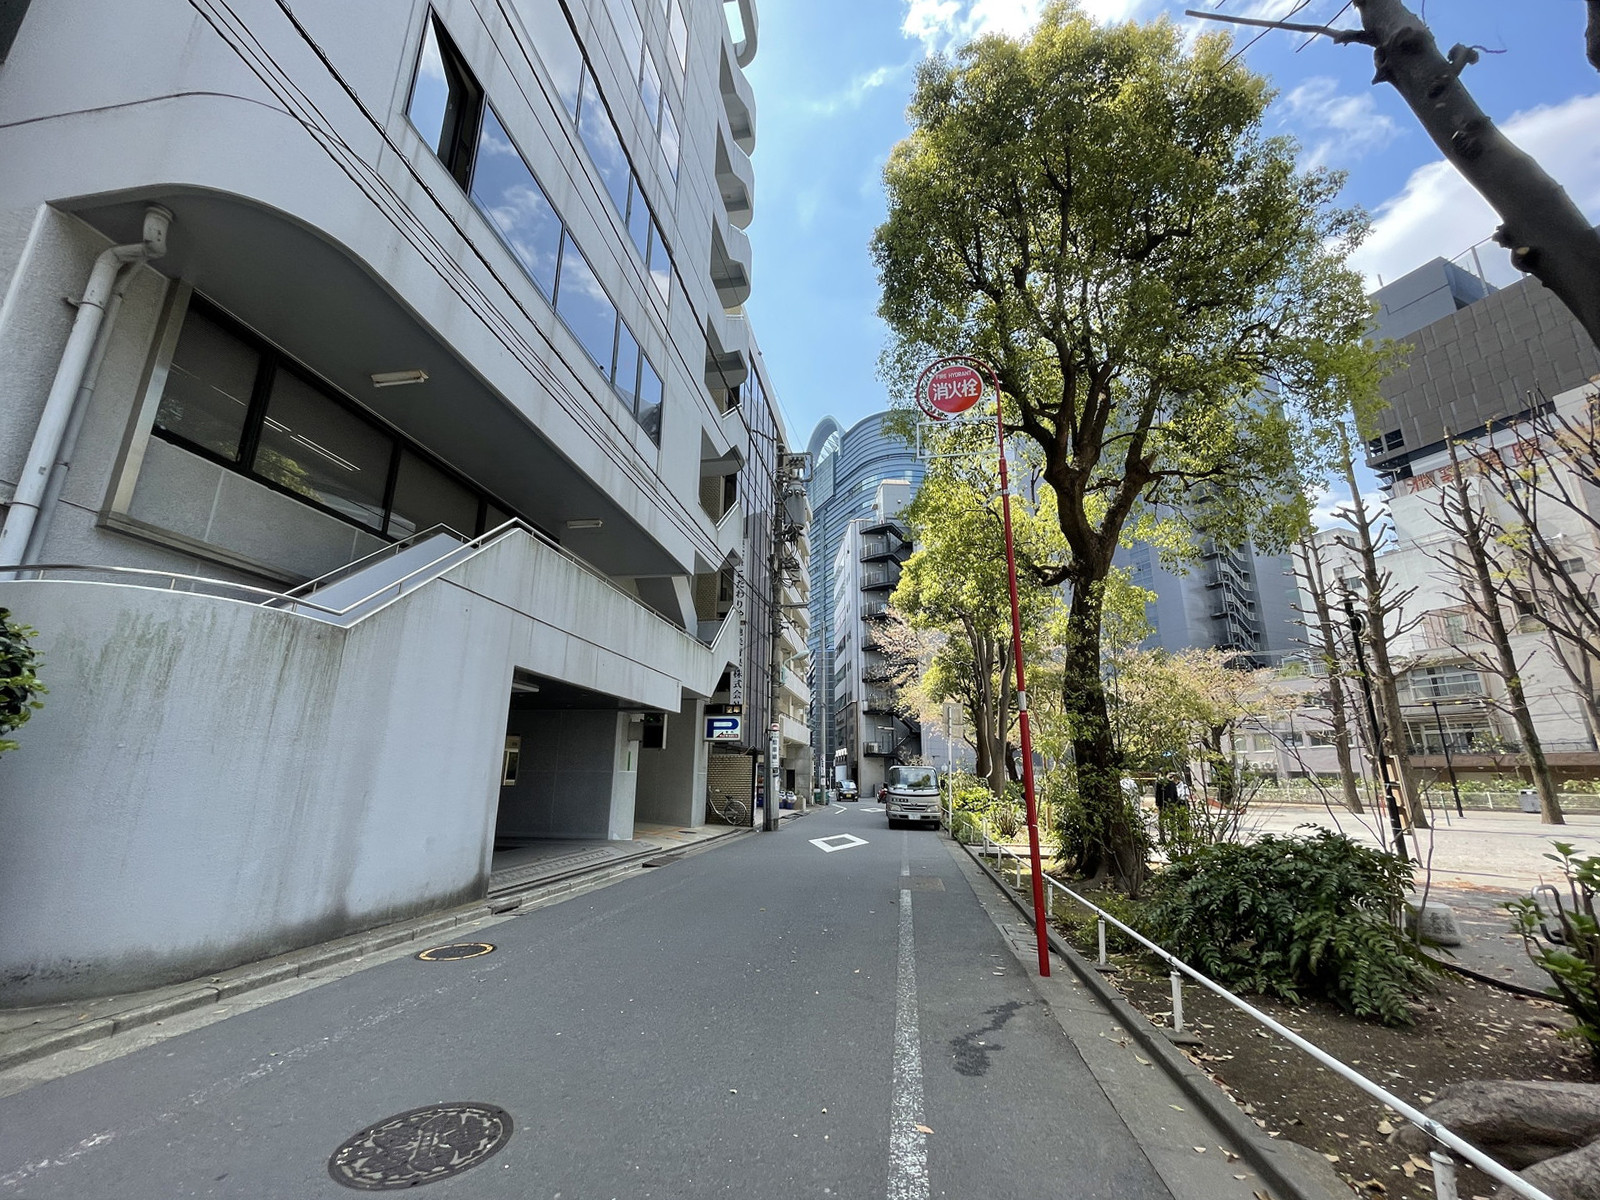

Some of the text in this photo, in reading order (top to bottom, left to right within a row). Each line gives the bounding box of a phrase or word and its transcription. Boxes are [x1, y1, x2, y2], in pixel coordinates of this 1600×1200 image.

[933, 378, 978, 401] 消火栓
[706, 718, 739, 738] P
